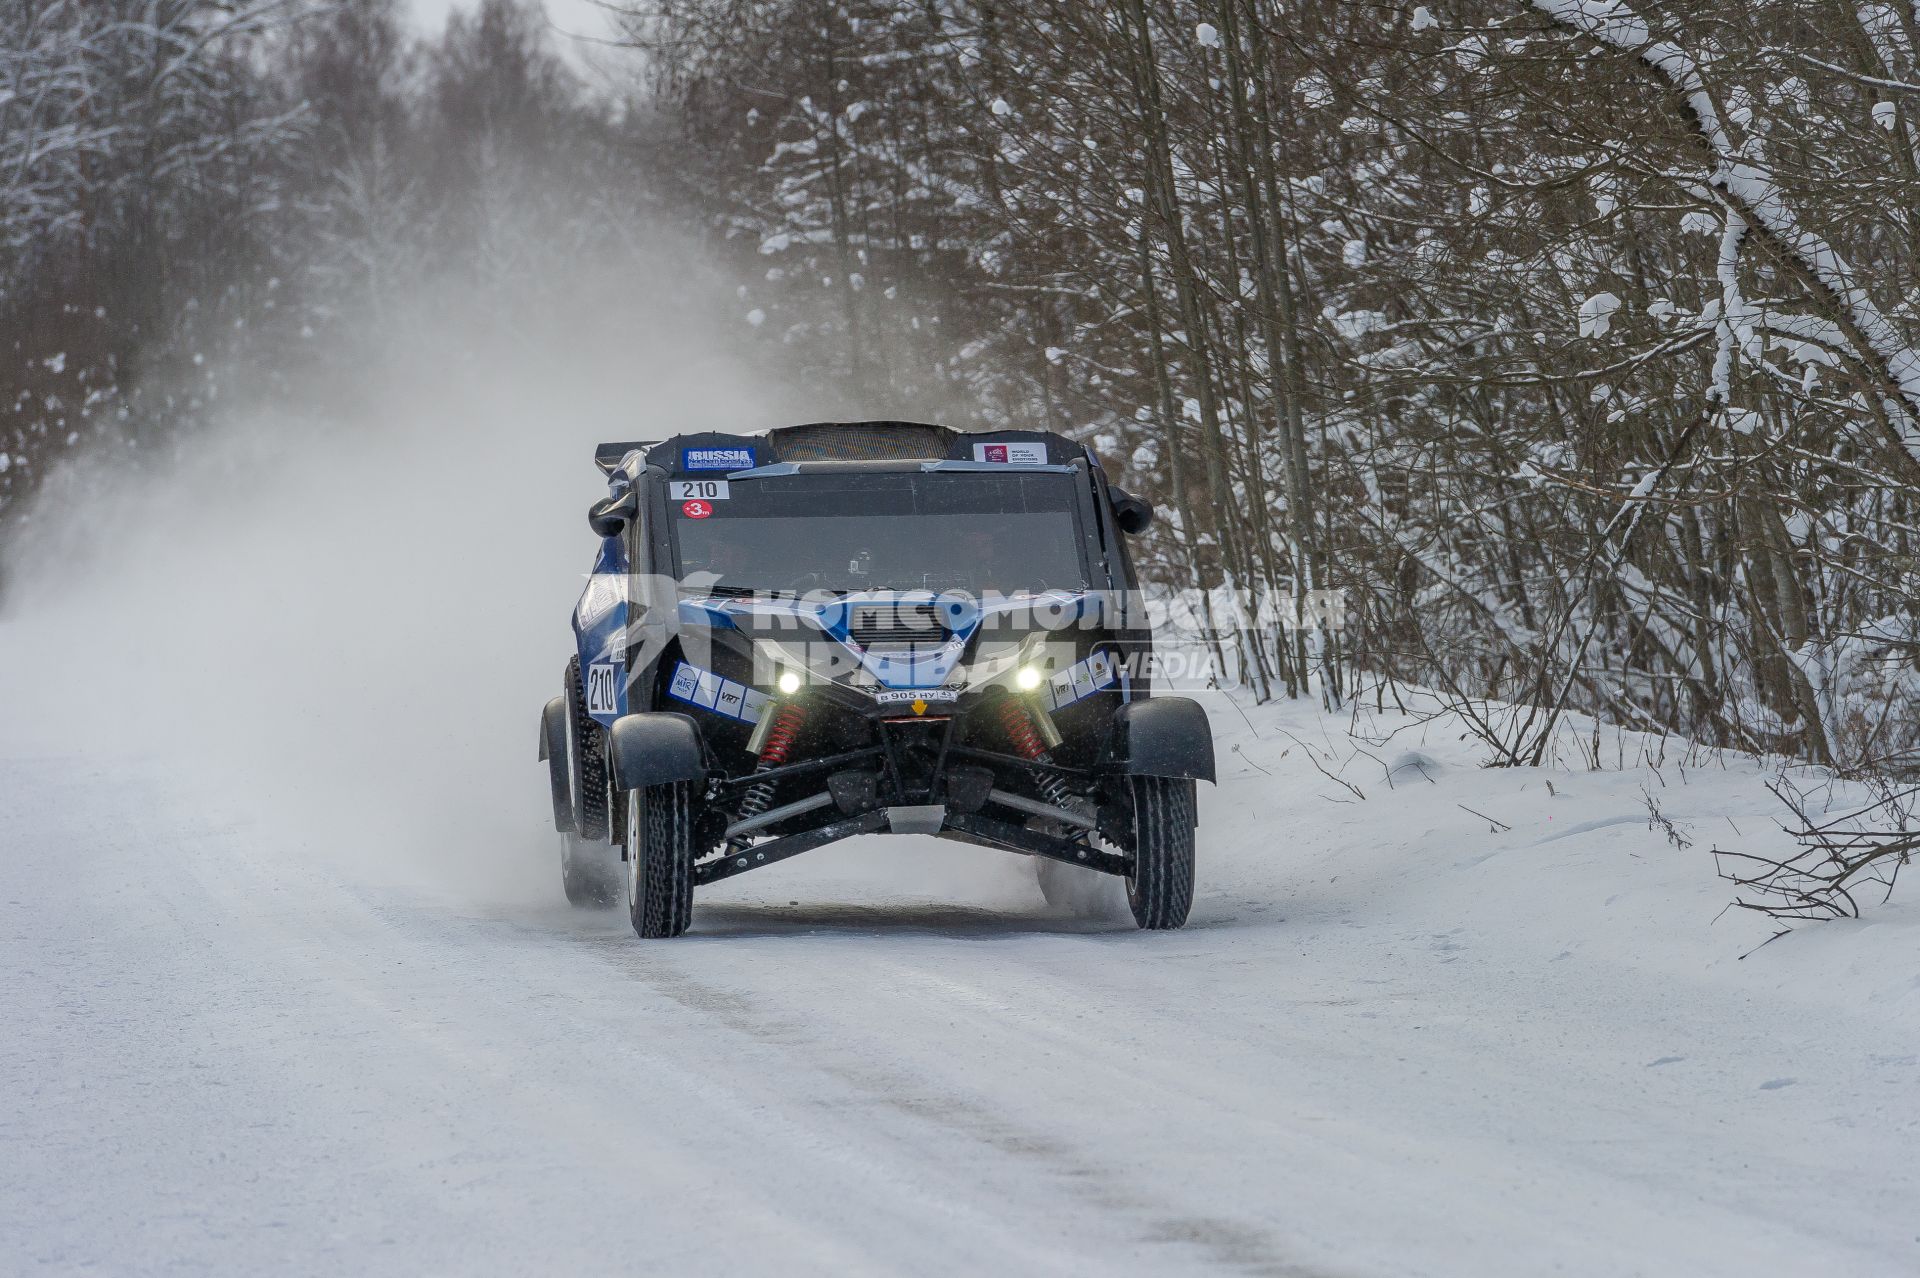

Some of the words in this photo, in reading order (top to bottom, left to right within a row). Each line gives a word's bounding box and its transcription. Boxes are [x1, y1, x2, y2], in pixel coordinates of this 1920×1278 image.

[692, 451, 750, 461] RUSSIA
[682, 482, 718, 498] 210
[590, 668, 613, 711] 210
[891, 691, 916, 700] 905
[722, 691, 741, 705] VRT
